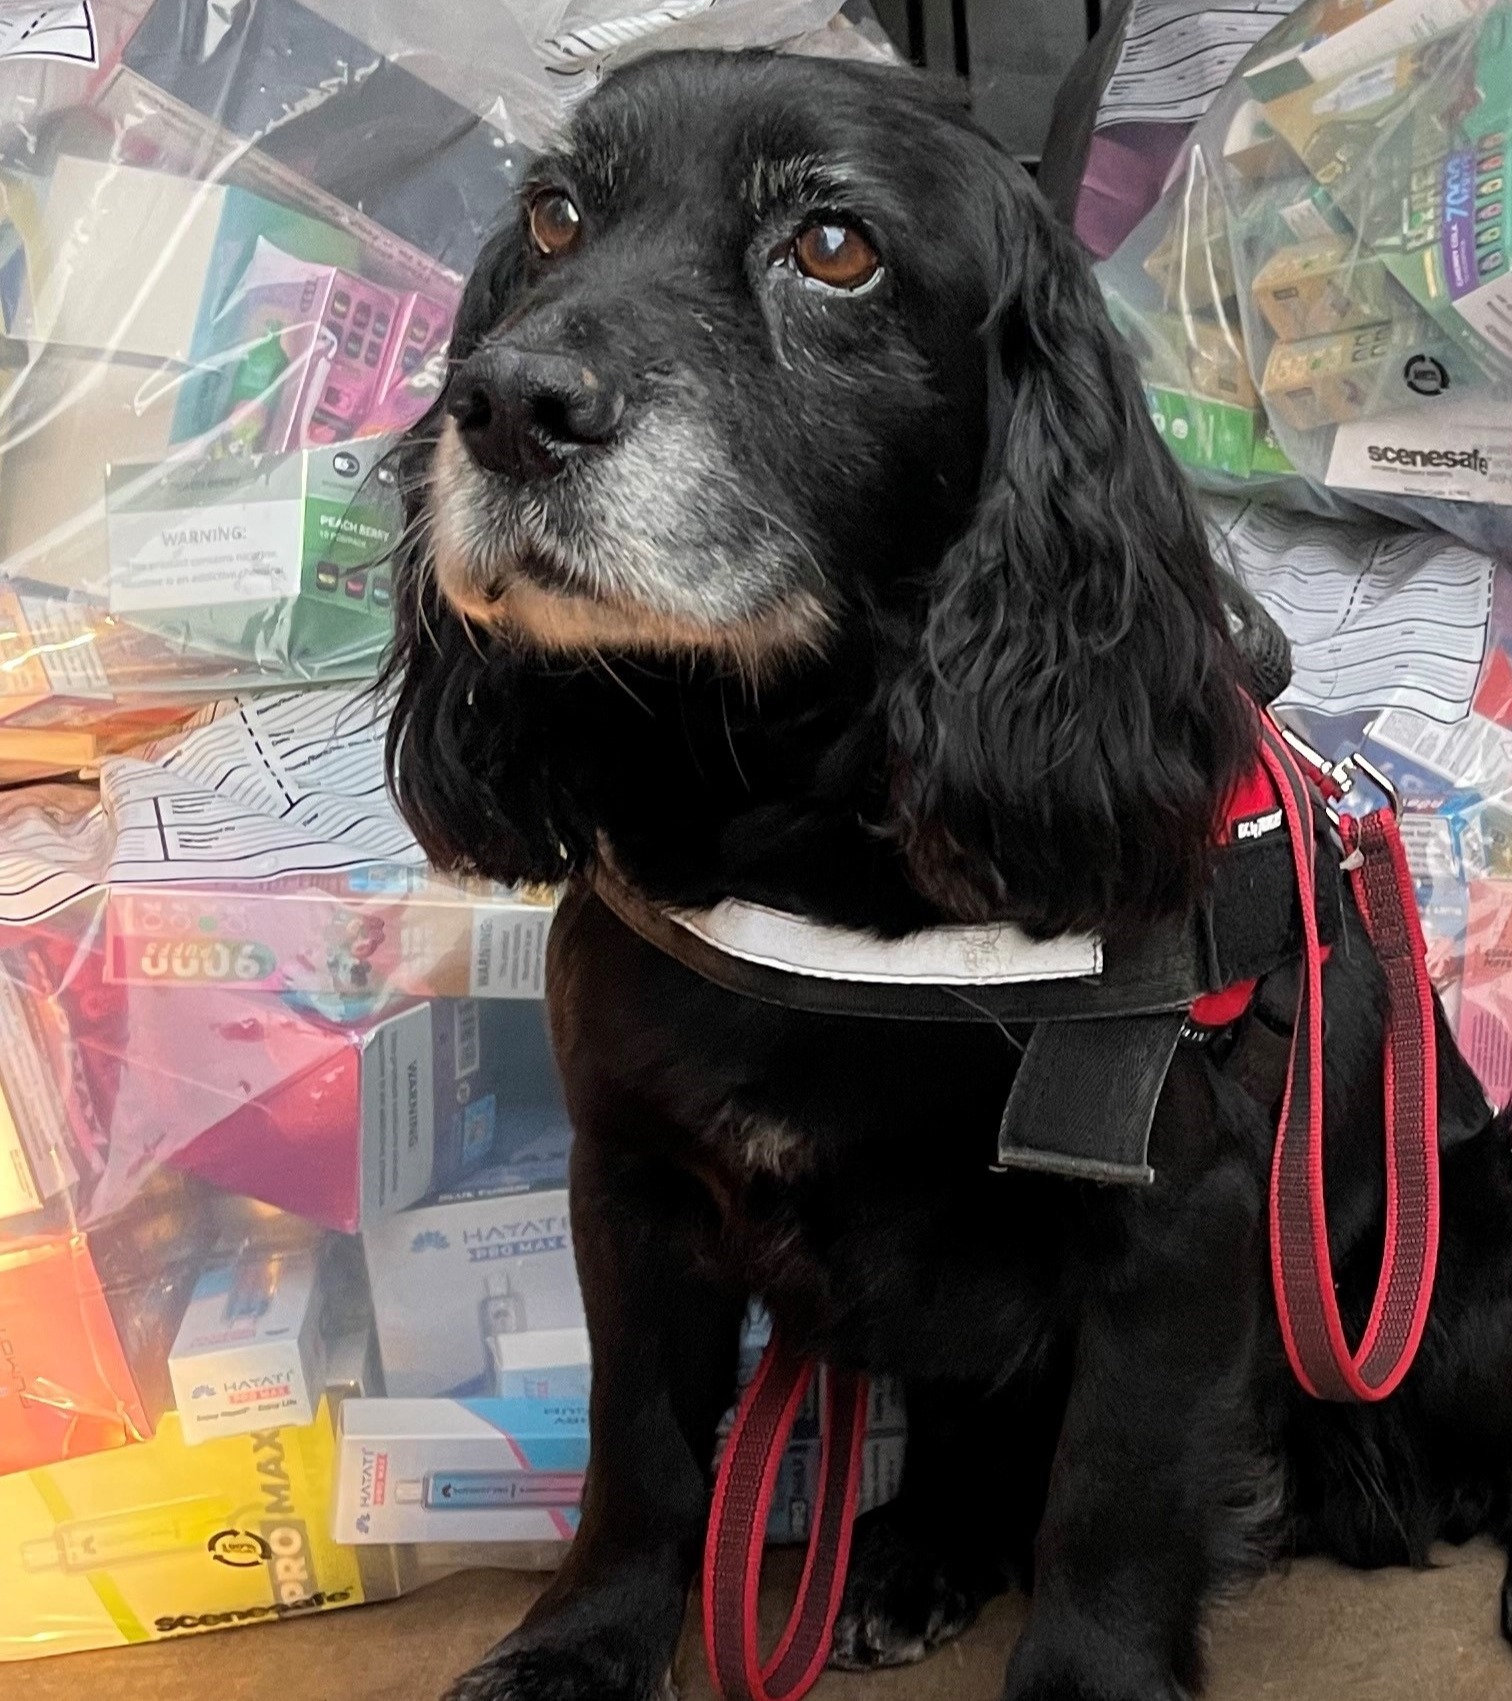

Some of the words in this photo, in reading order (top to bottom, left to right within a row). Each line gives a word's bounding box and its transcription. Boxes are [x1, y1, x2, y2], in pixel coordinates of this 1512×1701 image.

[1368, 445, 1490, 476] scenesafe
[161, 526, 248, 547] WARNING:
[462, 1215, 568, 1244] HAYATI
[518, 1235, 557, 1254] MAX
[252, 1429, 294, 1514] MAX
[361, 1447, 374, 1508] HAYATI
[269, 1526, 308, 1606] PRO
[154, 1589, 354, 1632] scenesafe
